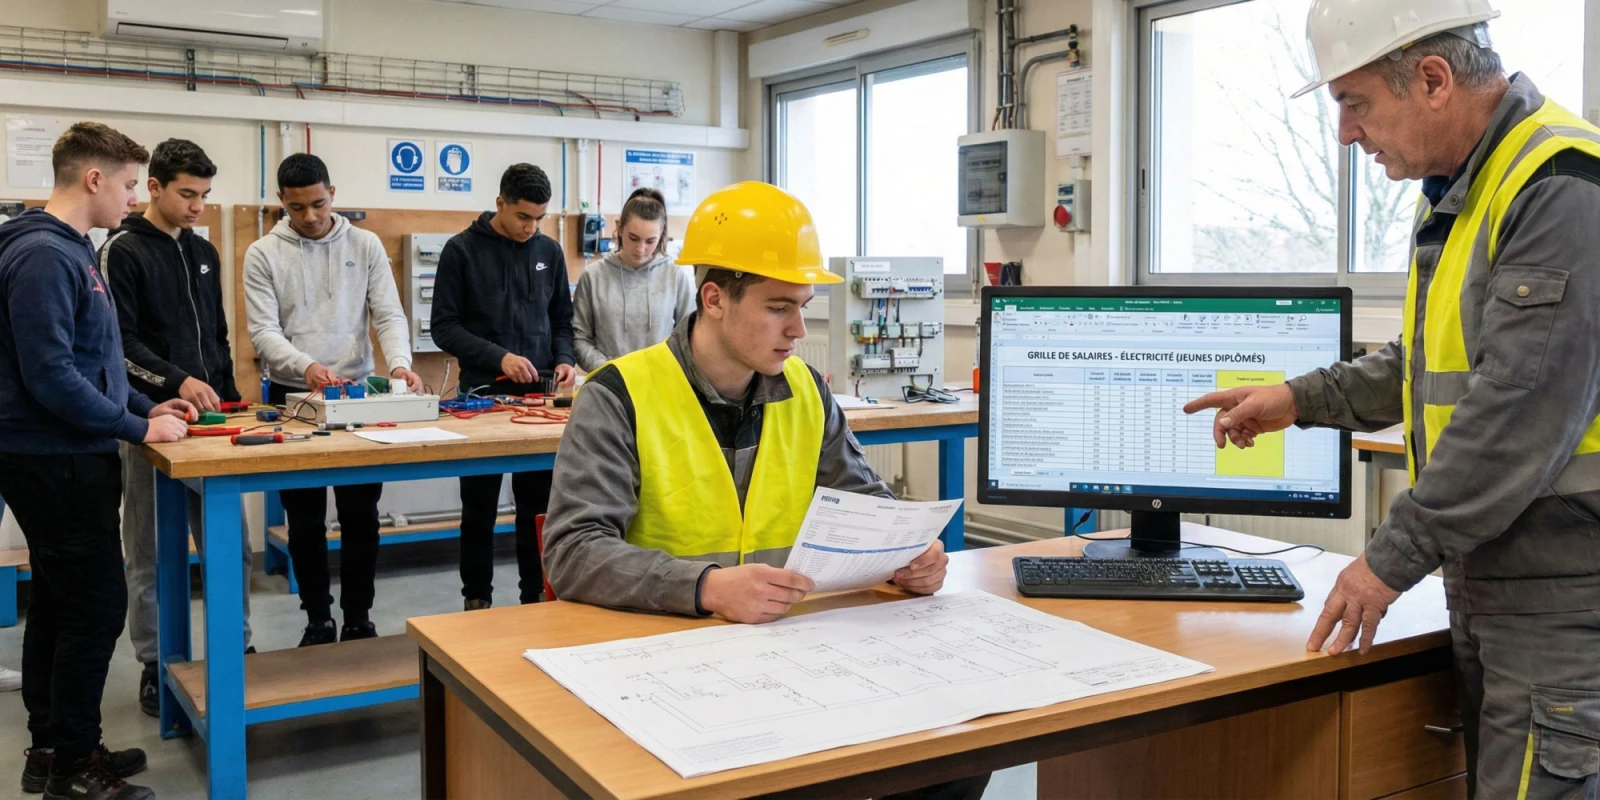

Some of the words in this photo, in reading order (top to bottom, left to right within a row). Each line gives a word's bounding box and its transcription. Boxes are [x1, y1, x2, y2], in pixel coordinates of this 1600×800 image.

[1028, 351, 1056, 360] GRILLE
[1059, 352, 1070, 360] DE
[1072, 352, 1113, 360] SALAIRES
[1120, 351, 1174, 361] ÉLECTRICITÉ
[1176, 353, 1213, 362] (JEUNES
